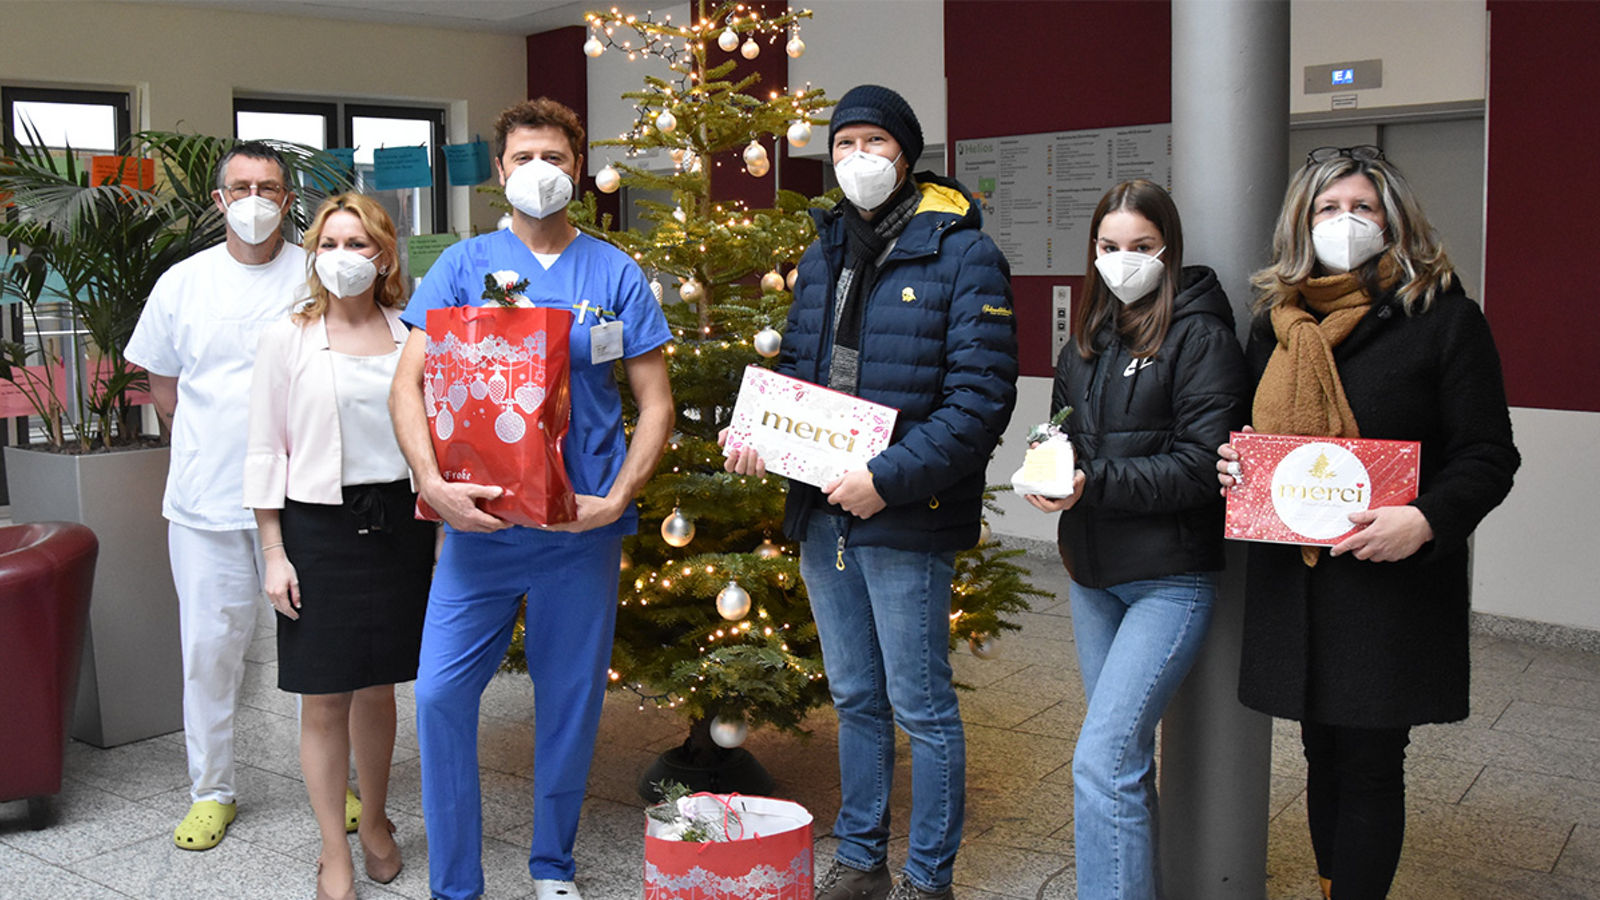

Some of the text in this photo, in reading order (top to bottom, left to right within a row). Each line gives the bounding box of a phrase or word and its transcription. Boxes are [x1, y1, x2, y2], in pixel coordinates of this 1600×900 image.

[965, 143, 993, 154] Helios
[761, 410, 859, 453] merci
[1279, 482, 1364, 503] merci
